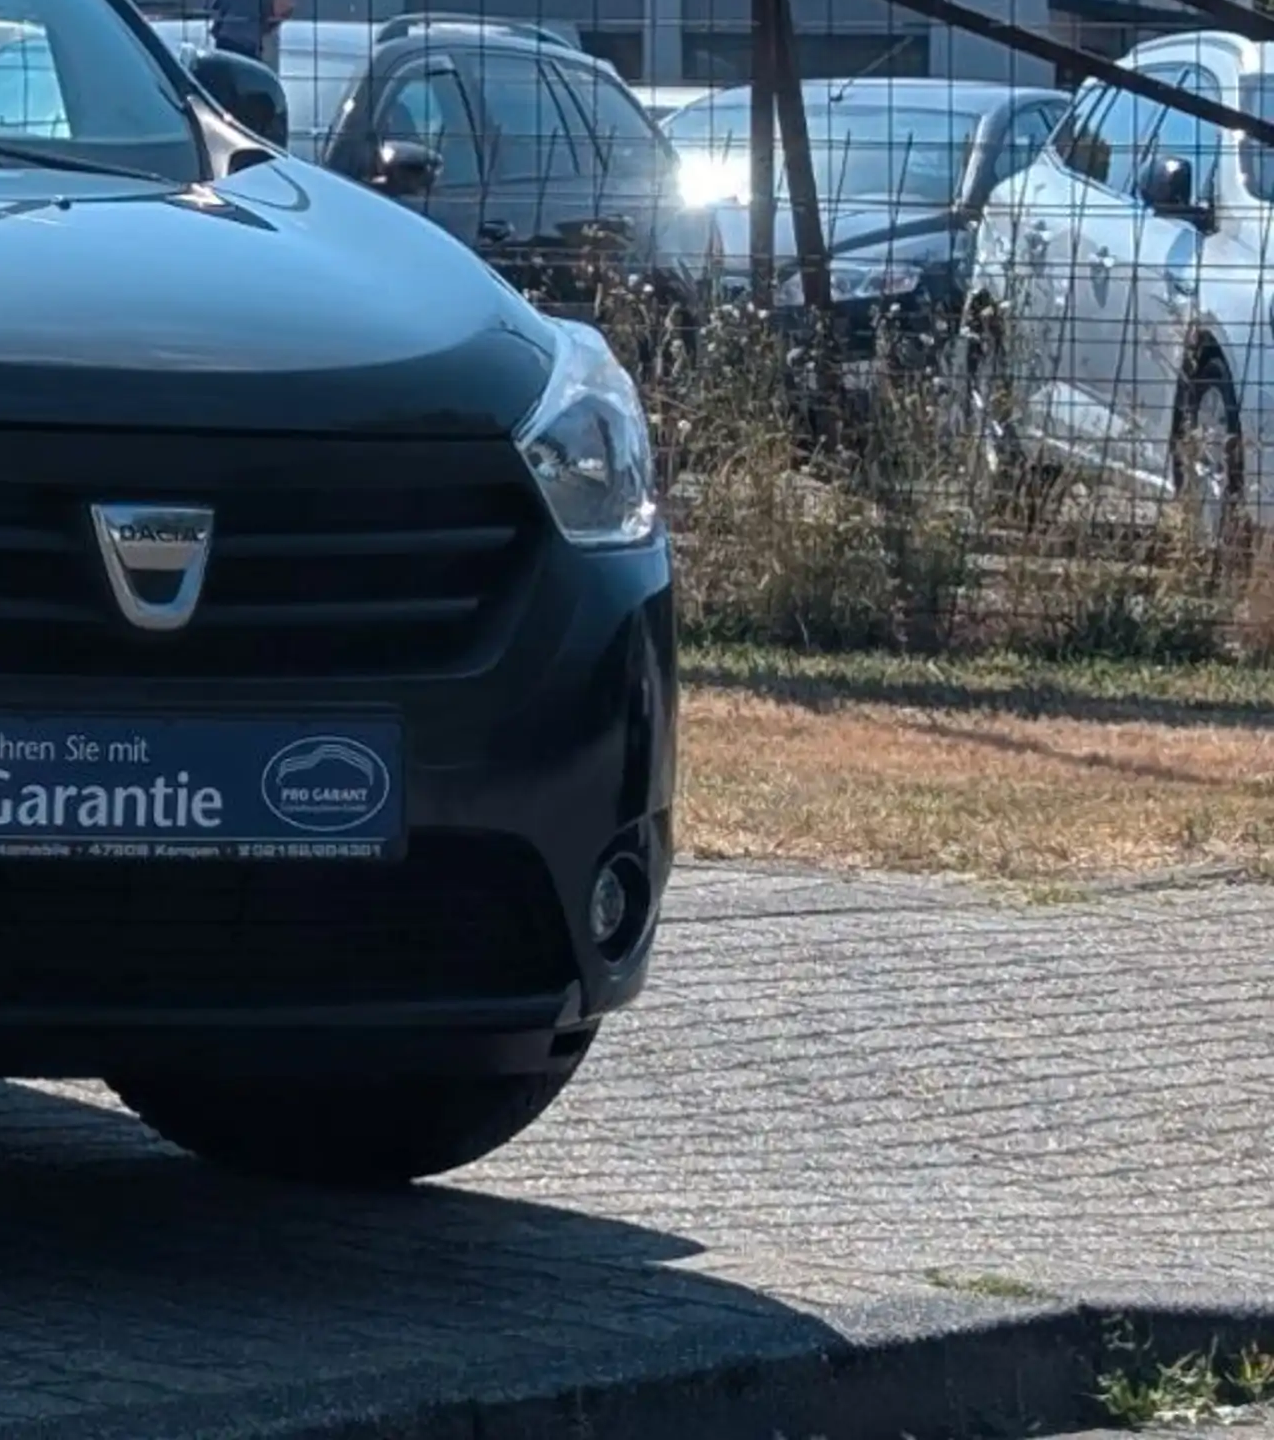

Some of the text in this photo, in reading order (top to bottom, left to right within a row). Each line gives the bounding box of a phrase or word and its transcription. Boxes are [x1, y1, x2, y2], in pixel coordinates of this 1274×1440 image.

[119, 524, 198, 543] DACIA
[65, 734, 100, 763] Sie
[108, 735, 150, 763] mit
